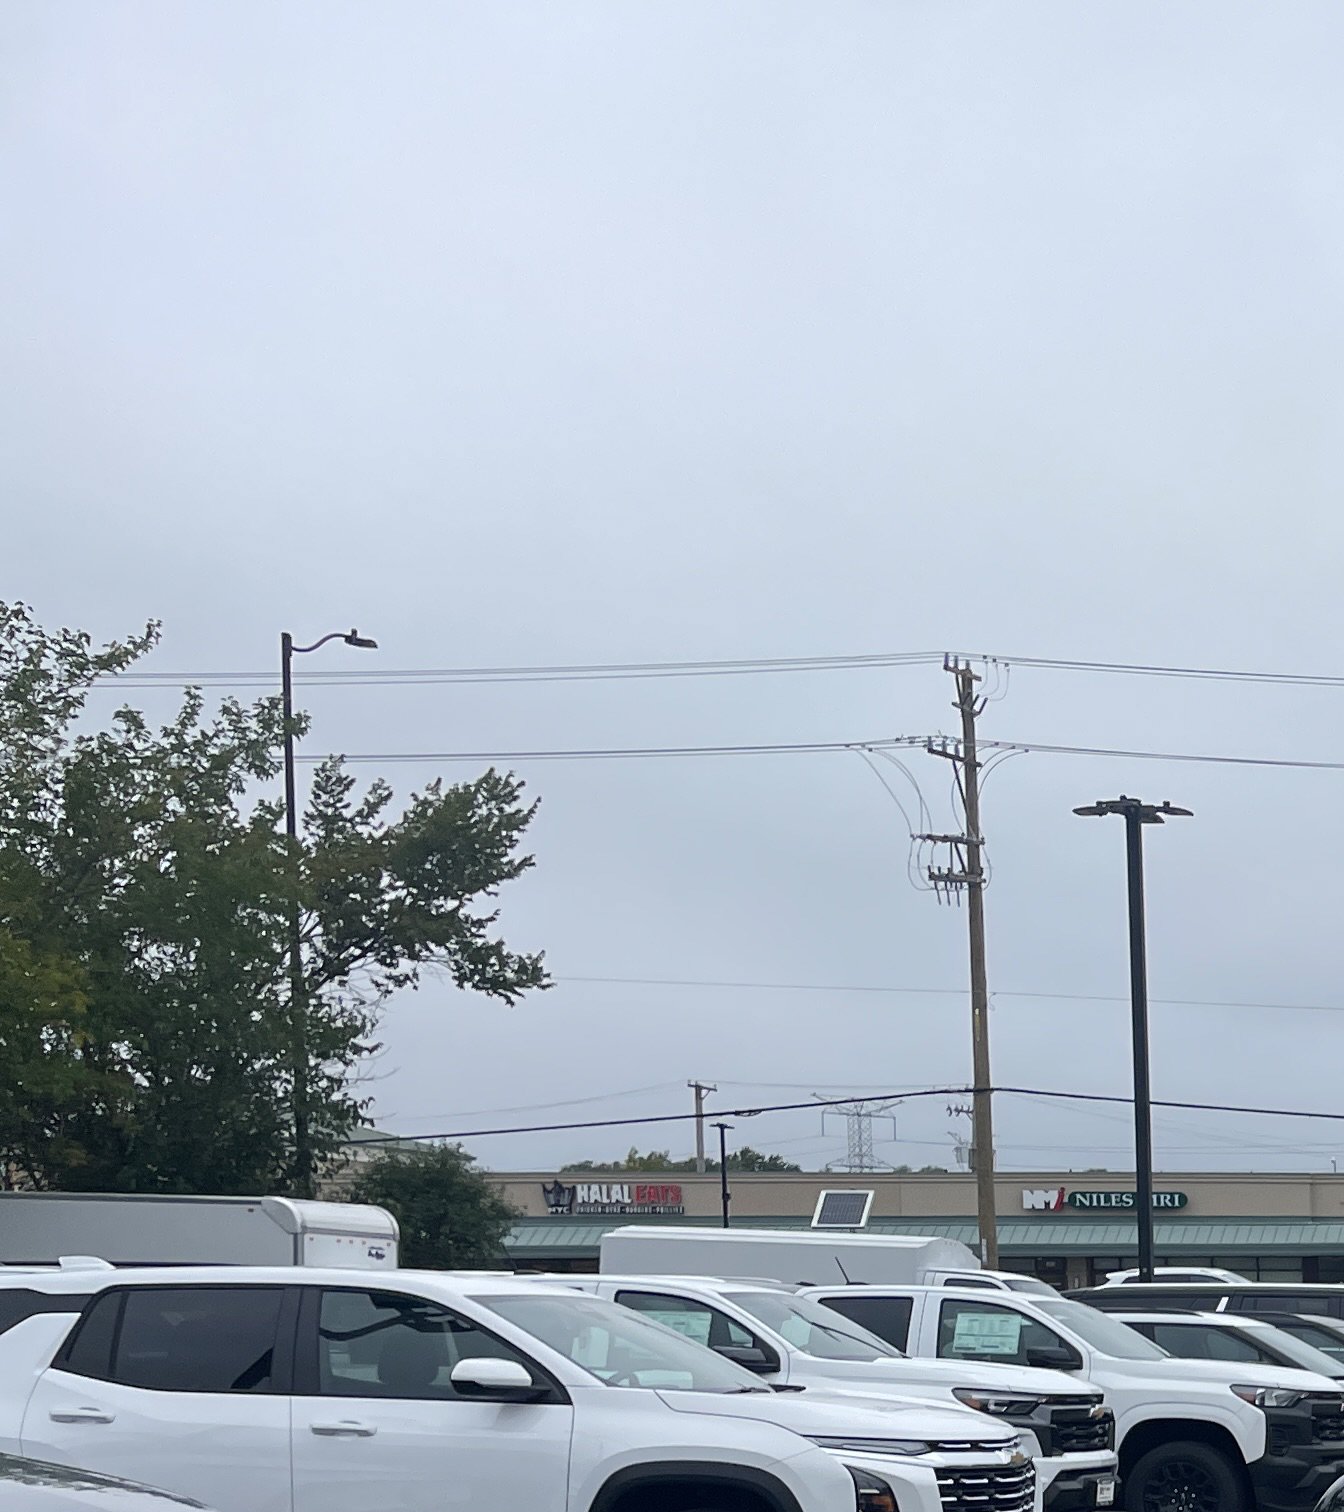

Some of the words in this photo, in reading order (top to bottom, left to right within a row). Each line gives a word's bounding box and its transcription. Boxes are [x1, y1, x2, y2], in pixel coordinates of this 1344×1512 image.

[577, 1184, 632, 1204] HALAL
[636, 1185, 682, 1205] EATS
[1075, 1193, 1133, 1207] NILES
[548, 1206, 570, 1214] NYC
